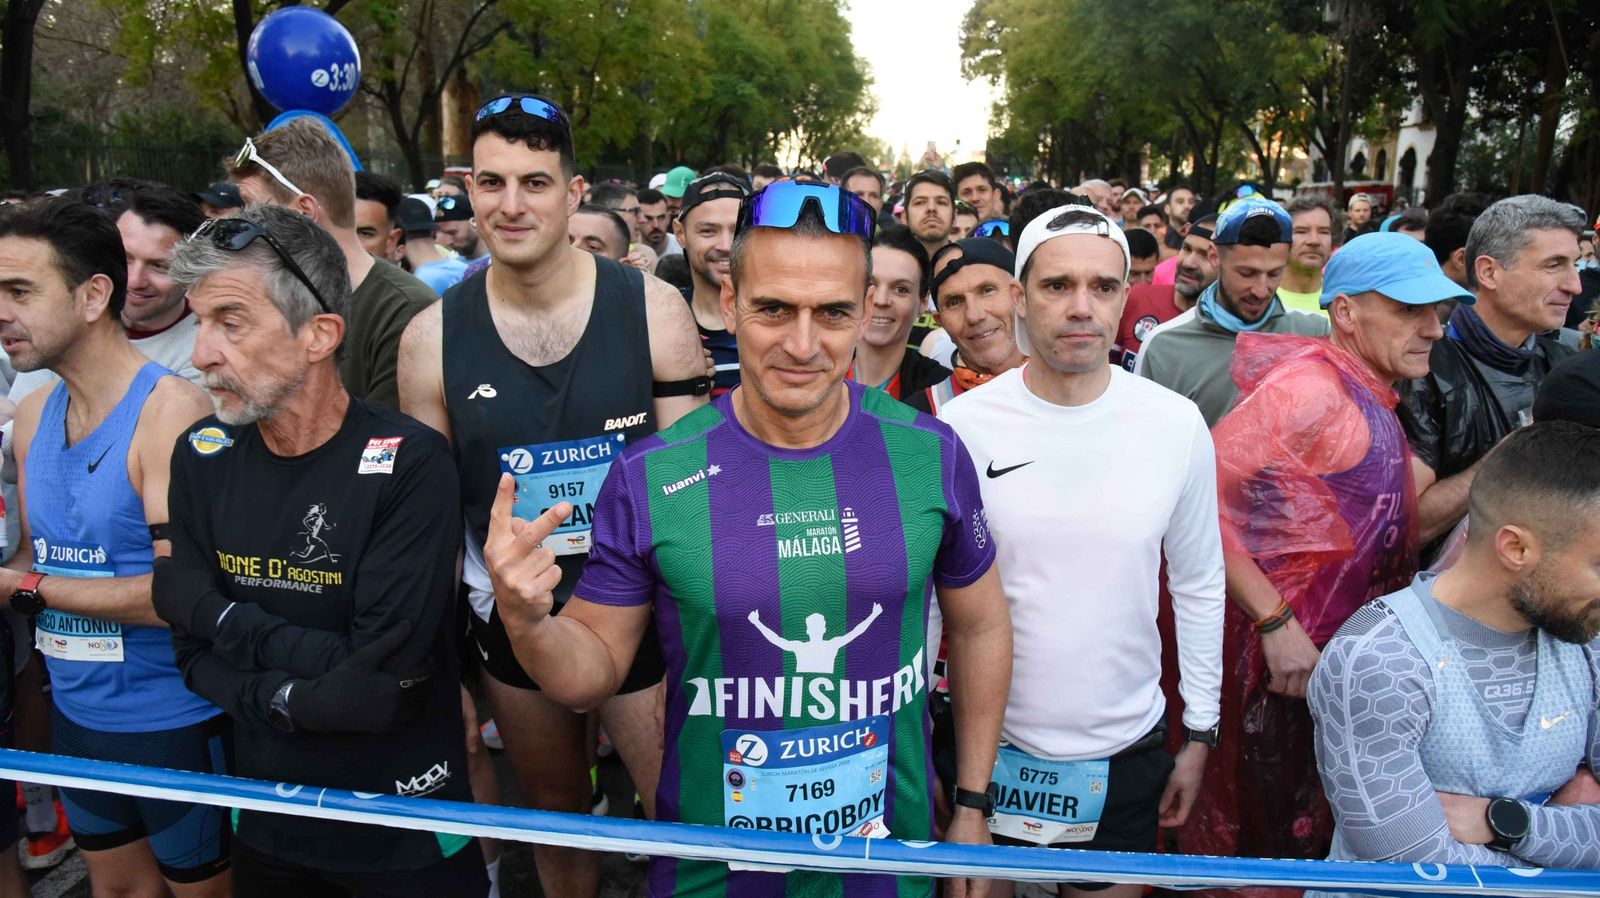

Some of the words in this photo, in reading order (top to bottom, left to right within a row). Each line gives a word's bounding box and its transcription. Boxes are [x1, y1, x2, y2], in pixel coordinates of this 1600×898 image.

[329, 63, 356, 91] 3:30
[541, 441, 611, 466] ZURICH
[549, 481, 585, 499] 9157
[662, 468, 706, 496] luanvi
[775, 508, 836, 525] GENERALI
[806, 525, 838, 537] MARATÓN
[50, 545, 99, 564] ZURICH
[778, 535, 843, 559] MÁLAGA
[234, 574, 324, 594] PERFORMANCE
[58, 615, 120, 634] ANTONIO
[714, 664, 914, 722] FINISHER
[1484, 680, 1536, 699] Q36.5
[779, 726, 871, 760] ZURICH
[1019, 766, 1059, 785] 6775
[785, 778, 835, 802] 7169
[996, 785, 1080, 819] JAVIER
